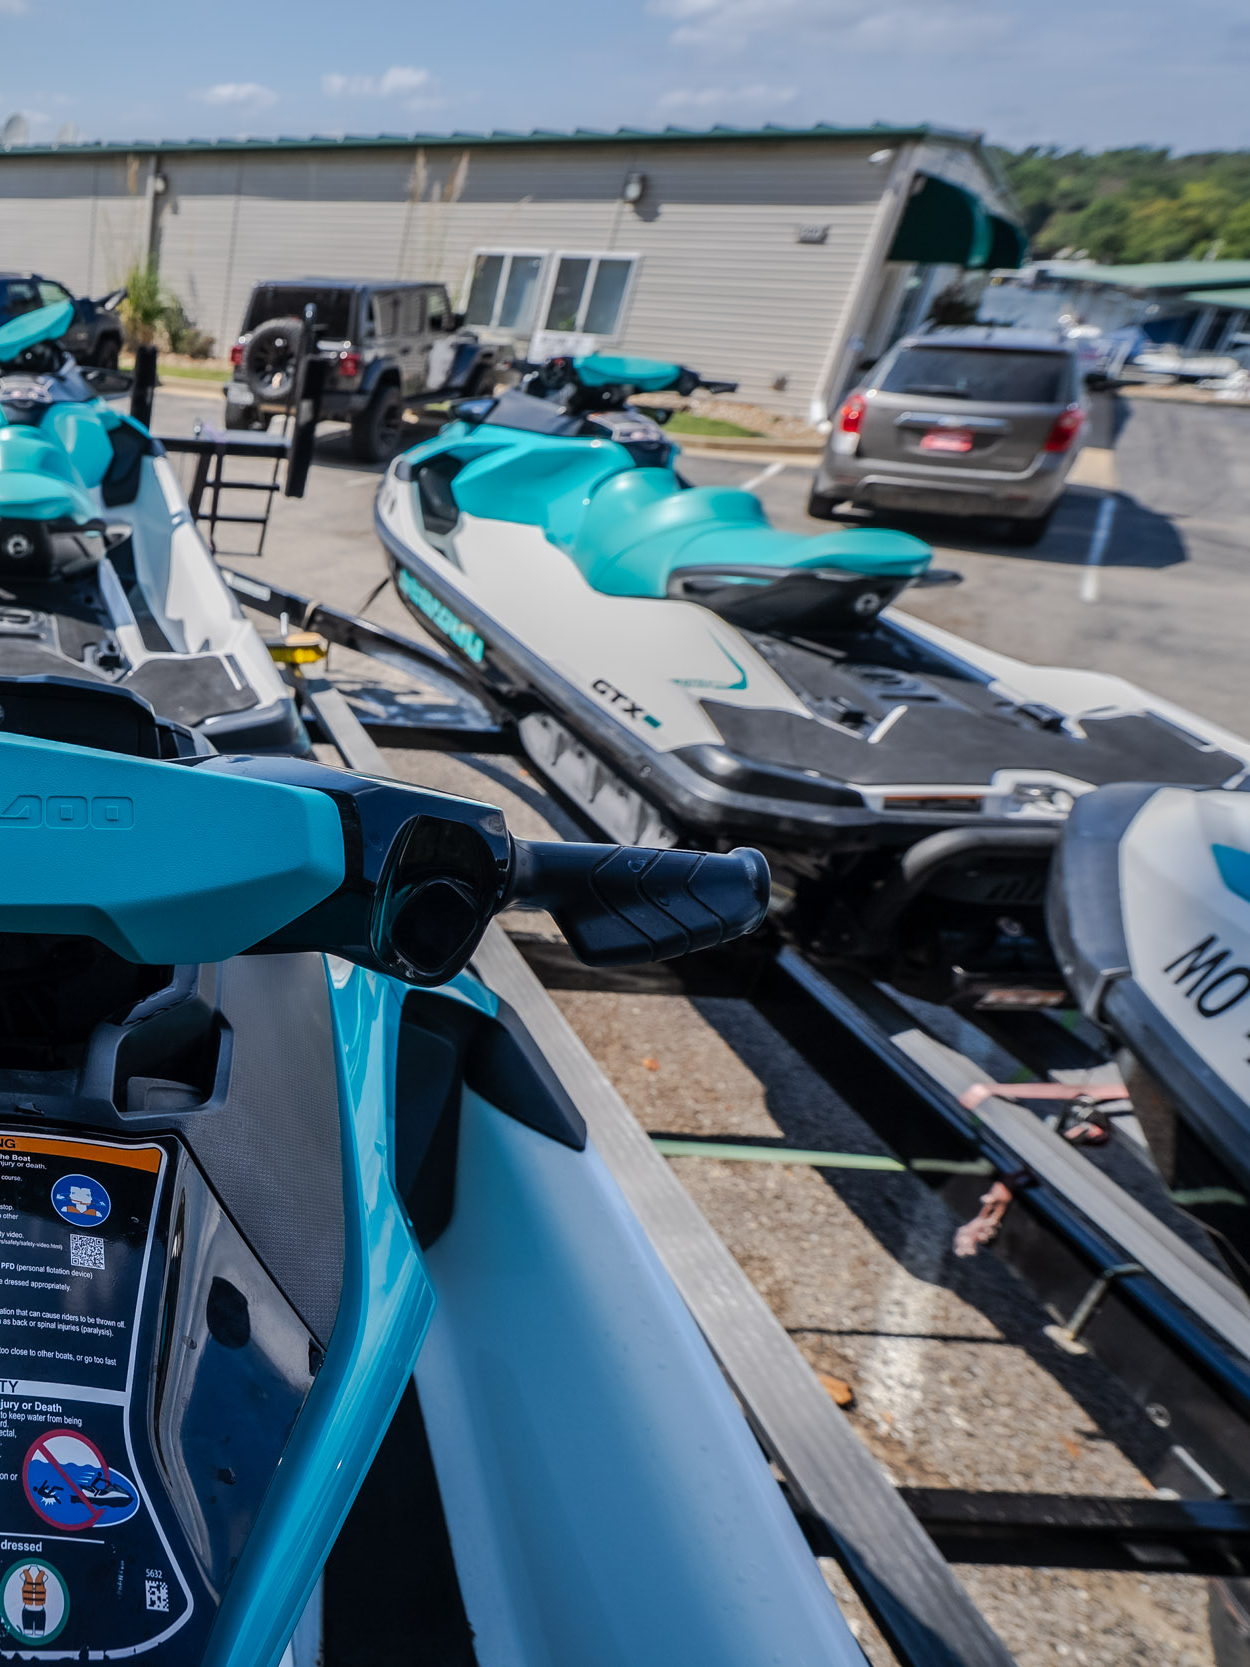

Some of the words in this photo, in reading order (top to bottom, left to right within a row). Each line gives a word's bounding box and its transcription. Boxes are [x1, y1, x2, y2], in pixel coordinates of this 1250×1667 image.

[592, 679, 644, 718] GTX
[1163, 933, 1250, 1018] MO
[11, 1154, 30, 1162] Boat
[16, 1264, 45, 1272] (personal
[46, 1266, 70, 1274] flotation
[70, 1269, 92, 1278] device)
[34, 1402, 62, 1412] Death
[0, 1411, 7, 1420] to
[8, 1412, 25, 1420] keep
[63, 1416, 82, 1426] being
[1, 1539, 43, 1552] dressed
[146, 1568, 163, 1579] 5632
